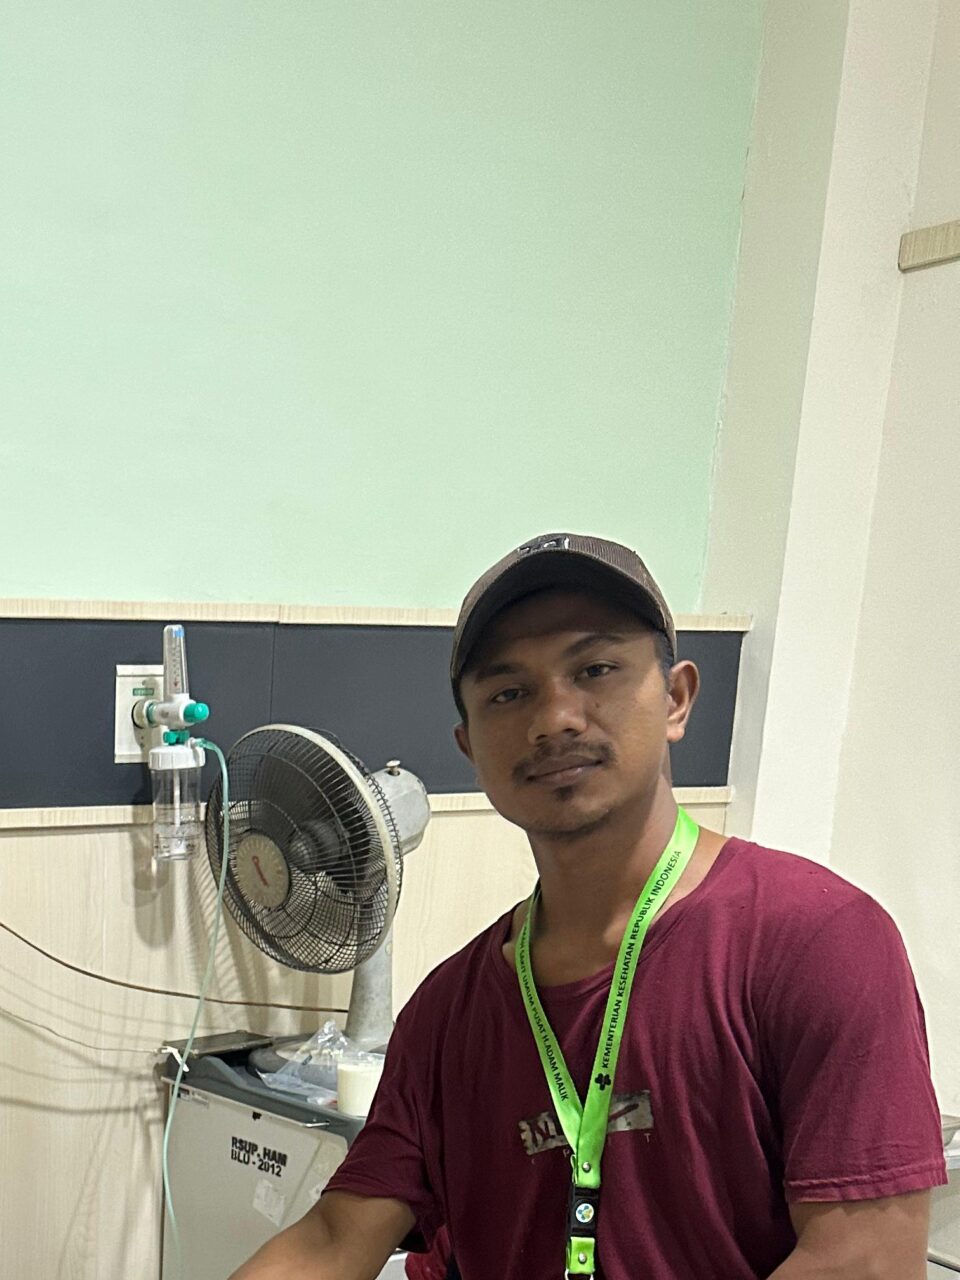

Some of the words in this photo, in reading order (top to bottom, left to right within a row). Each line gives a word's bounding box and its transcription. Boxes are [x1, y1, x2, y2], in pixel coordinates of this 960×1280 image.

[602, 999, 622, 1069] KEMENTERIAN
[617, 942, 635, 998] KESEHATAN
[630, 897, 655, 941] REPUBLIK
[650, 850, 682, 896] INDONESIA
[532, 1007, 546, 1034] PUSAT
[554, 1073, 568, 1102] MALIK
[257, 1158, 282, 1178] 2012
[262, 1147, 288, 1167] HAM
